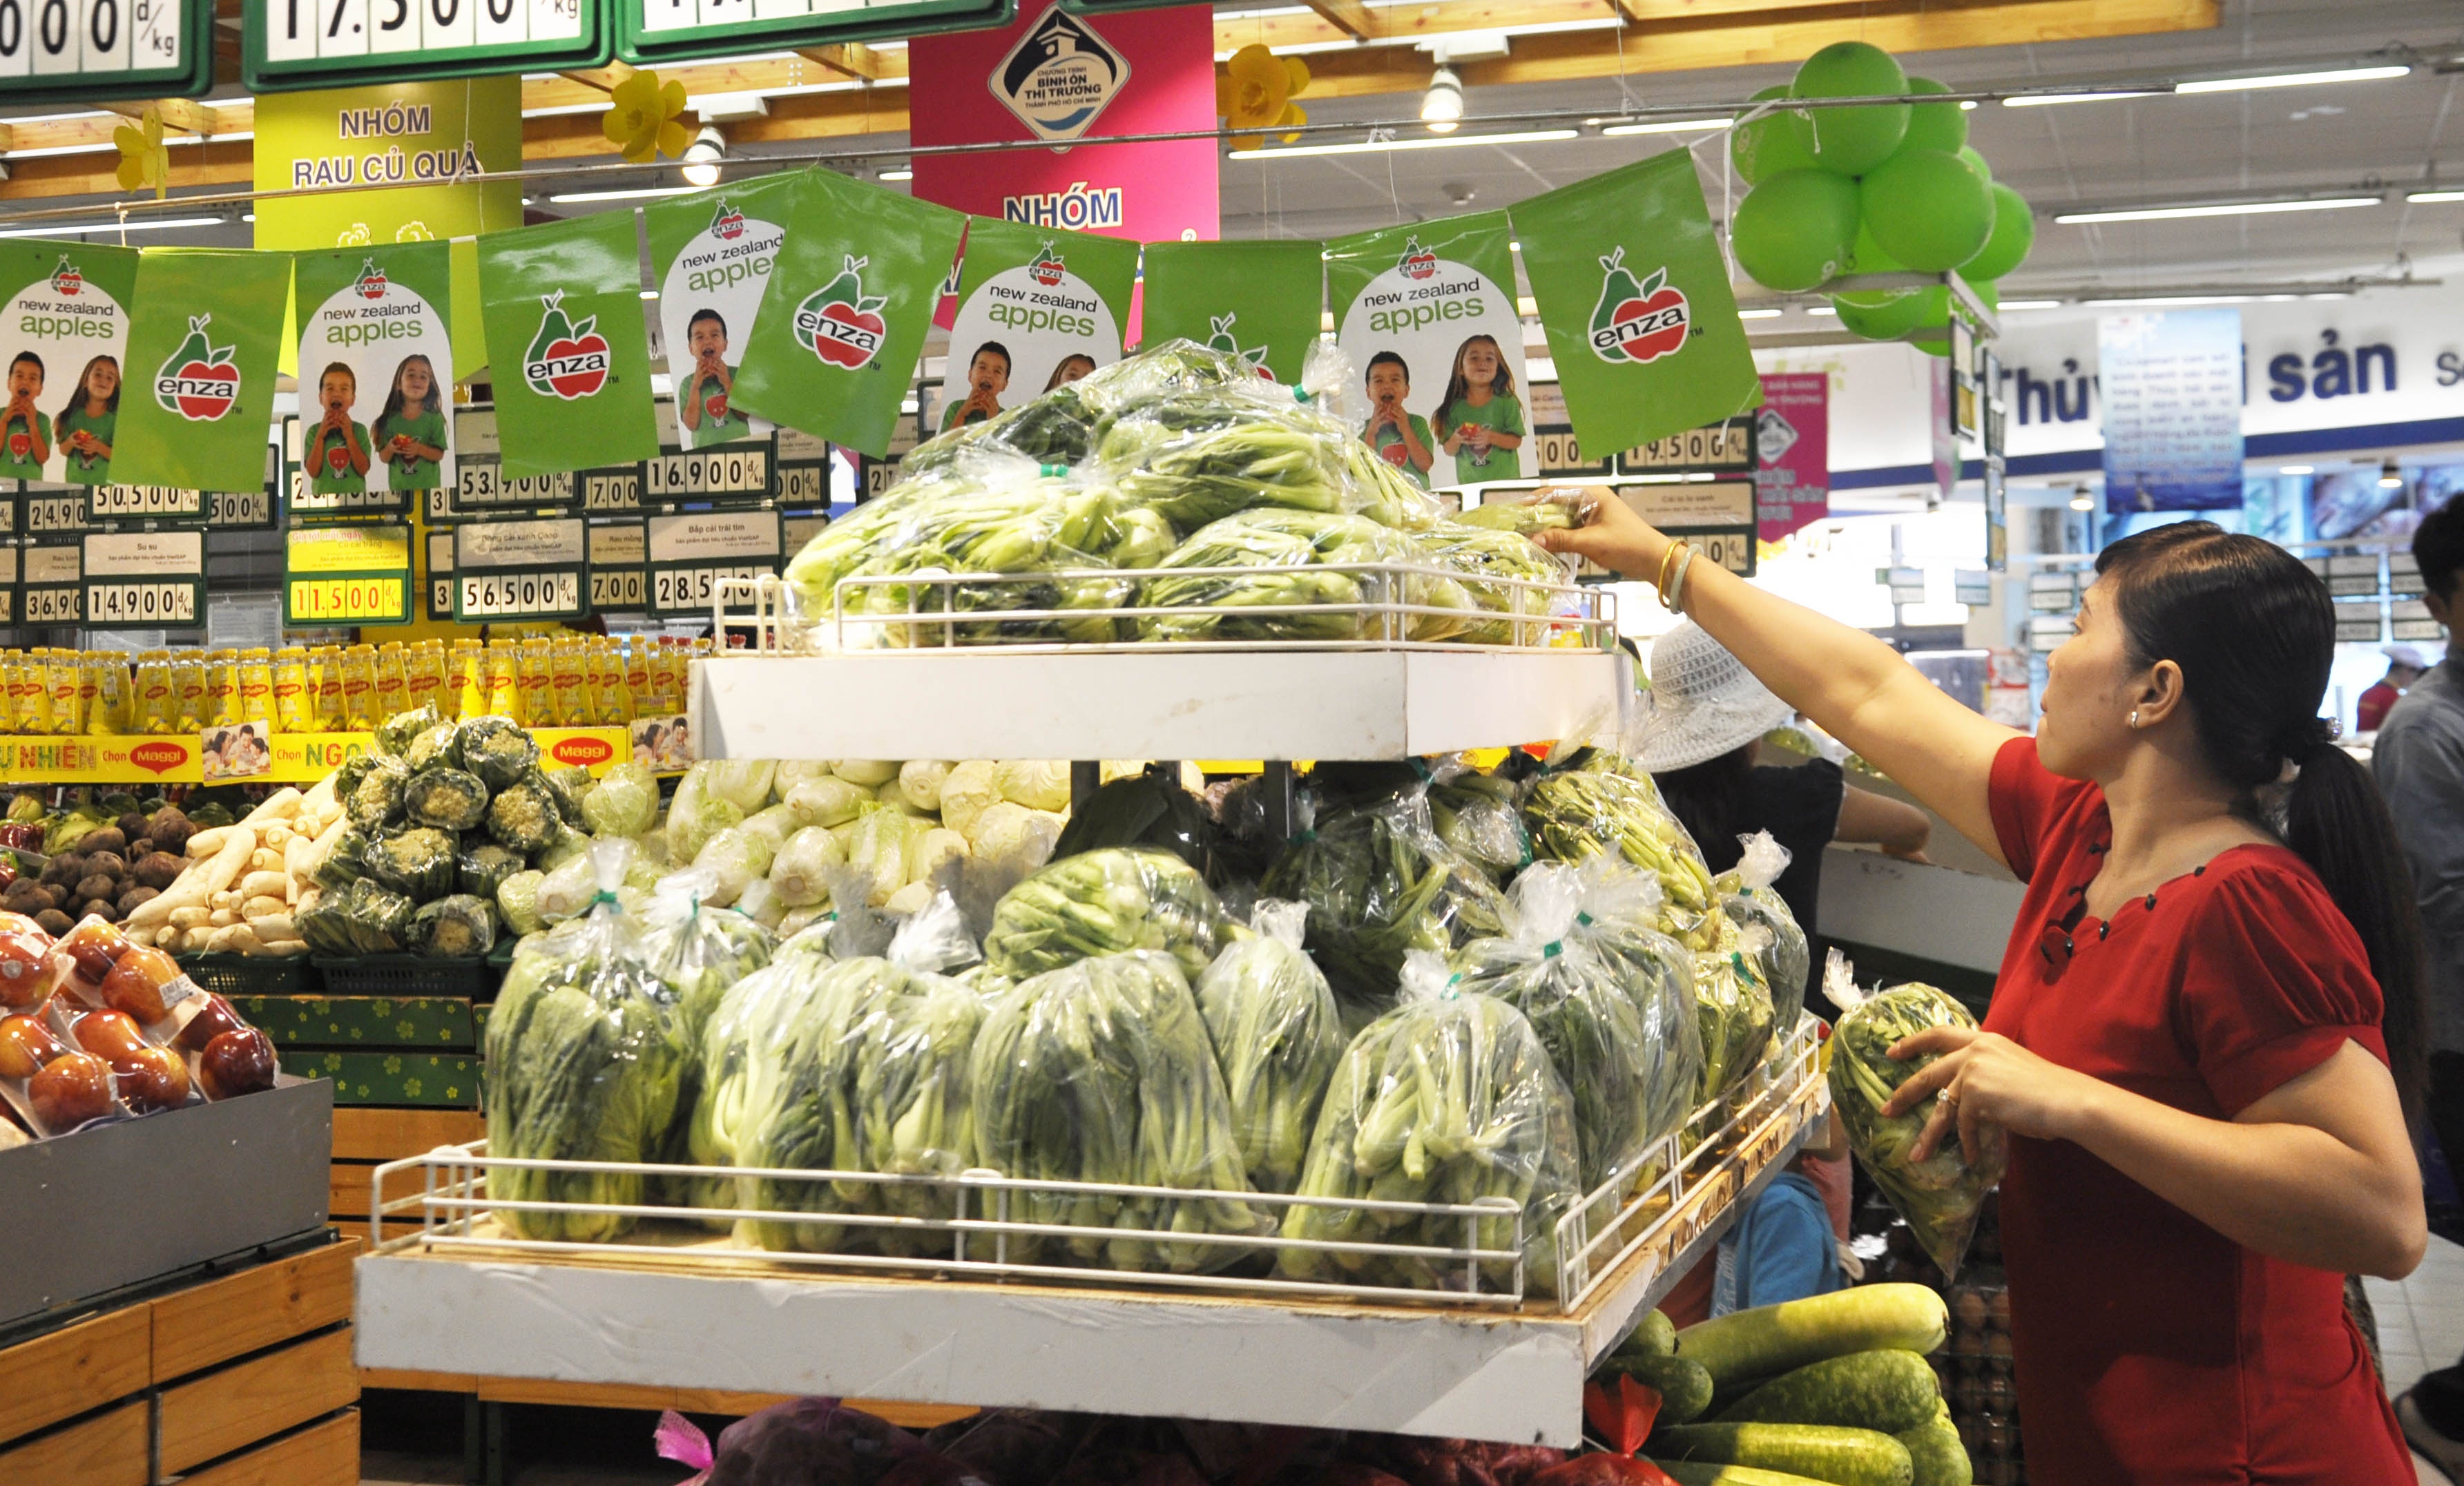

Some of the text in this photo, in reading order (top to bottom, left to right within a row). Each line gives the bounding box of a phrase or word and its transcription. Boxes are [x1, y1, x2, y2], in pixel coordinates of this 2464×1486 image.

[1025, 84, 1102, 101] THỊ TRƯỜNG
[1037, 76, 1067, 88] BÌNH
[340, 104, 431, 138] NHÓM
[295, 142, 480, 188] RAU CỦ QUẢ
[1004, 182, 1123, 230] NHÓM
[711, 221, 744, 235] enza
[682, 233, 784, 269] new zealand
[1029, 266, 1062, 279] enza
[1399, 261, 1435, 273] enza
[51, 280, 81, 289] enza
[354, 282, 386, 292] enza
[1365, 277, 1481, 308] new zealand
[19, 300, 114, 316] new zealand
[324, 301, 421, 321] new zealand
[990, 285, 1097, 313] new zealand
[20, 316, 115, 340] apples
[988, 302, 1095, 338] apples
[1369, 298, 1485, 335] apples
[1593, 307, 1686, 348] enza
[327, 318, 423, 348] apples
[796, 311, 878, 352] enza
[1689, 327, 1704, 338] TM
[526, 352, 606, 380] enza
[2269, 328, 2397, 404] sản
[157, 376, 234, 398] enza
[653, 459, 742, 488] 16.900
[97, 486, 178, 507] 50.500
[93, 590, 174, 615] 14.900
[298, 586, 379, 612] 11.500
[467, 580, 555, 607] 56.500
[20, 739, 97, 771] NHIÊN
[103, 750, 127, 766] Chọn
[137, 749, 181, 766] Maggi
[277, 749, 301, 764] Chọn
[559, 745, 606, 758] Maggi
